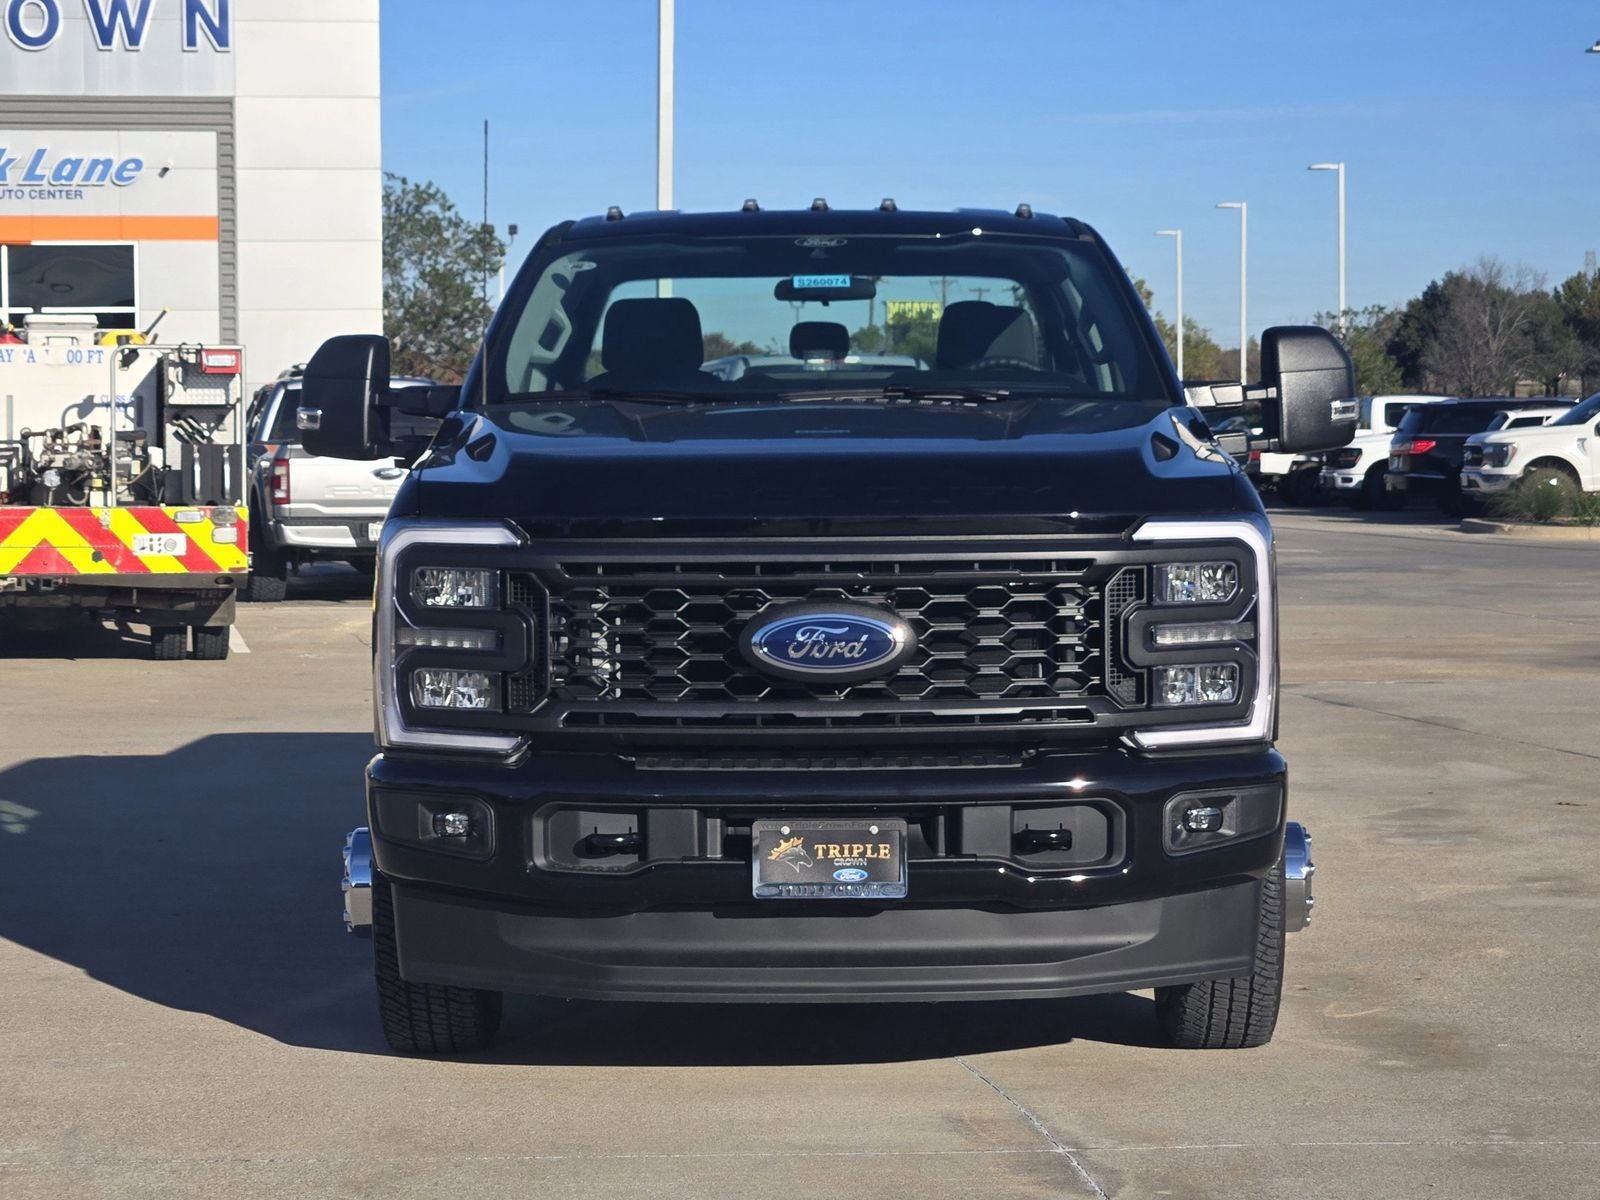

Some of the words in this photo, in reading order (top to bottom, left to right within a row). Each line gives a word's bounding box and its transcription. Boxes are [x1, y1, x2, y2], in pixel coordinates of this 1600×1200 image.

[3, 0, 230, 51] OWN
[21, 148, 144, 183] Lane
[28, 189, 83, 200] CENTER
[797, 277, 848, 287] S260074
[87, 349, 104, 364] FT
[788, 625, 869, 658] Ford
[814, 844, 891, 860] TRIPLE
[833, 858, 868, 867] CROWN
[839, 871, 861, 881] Ford
[779, 885, 832, 897] TRIPLE
